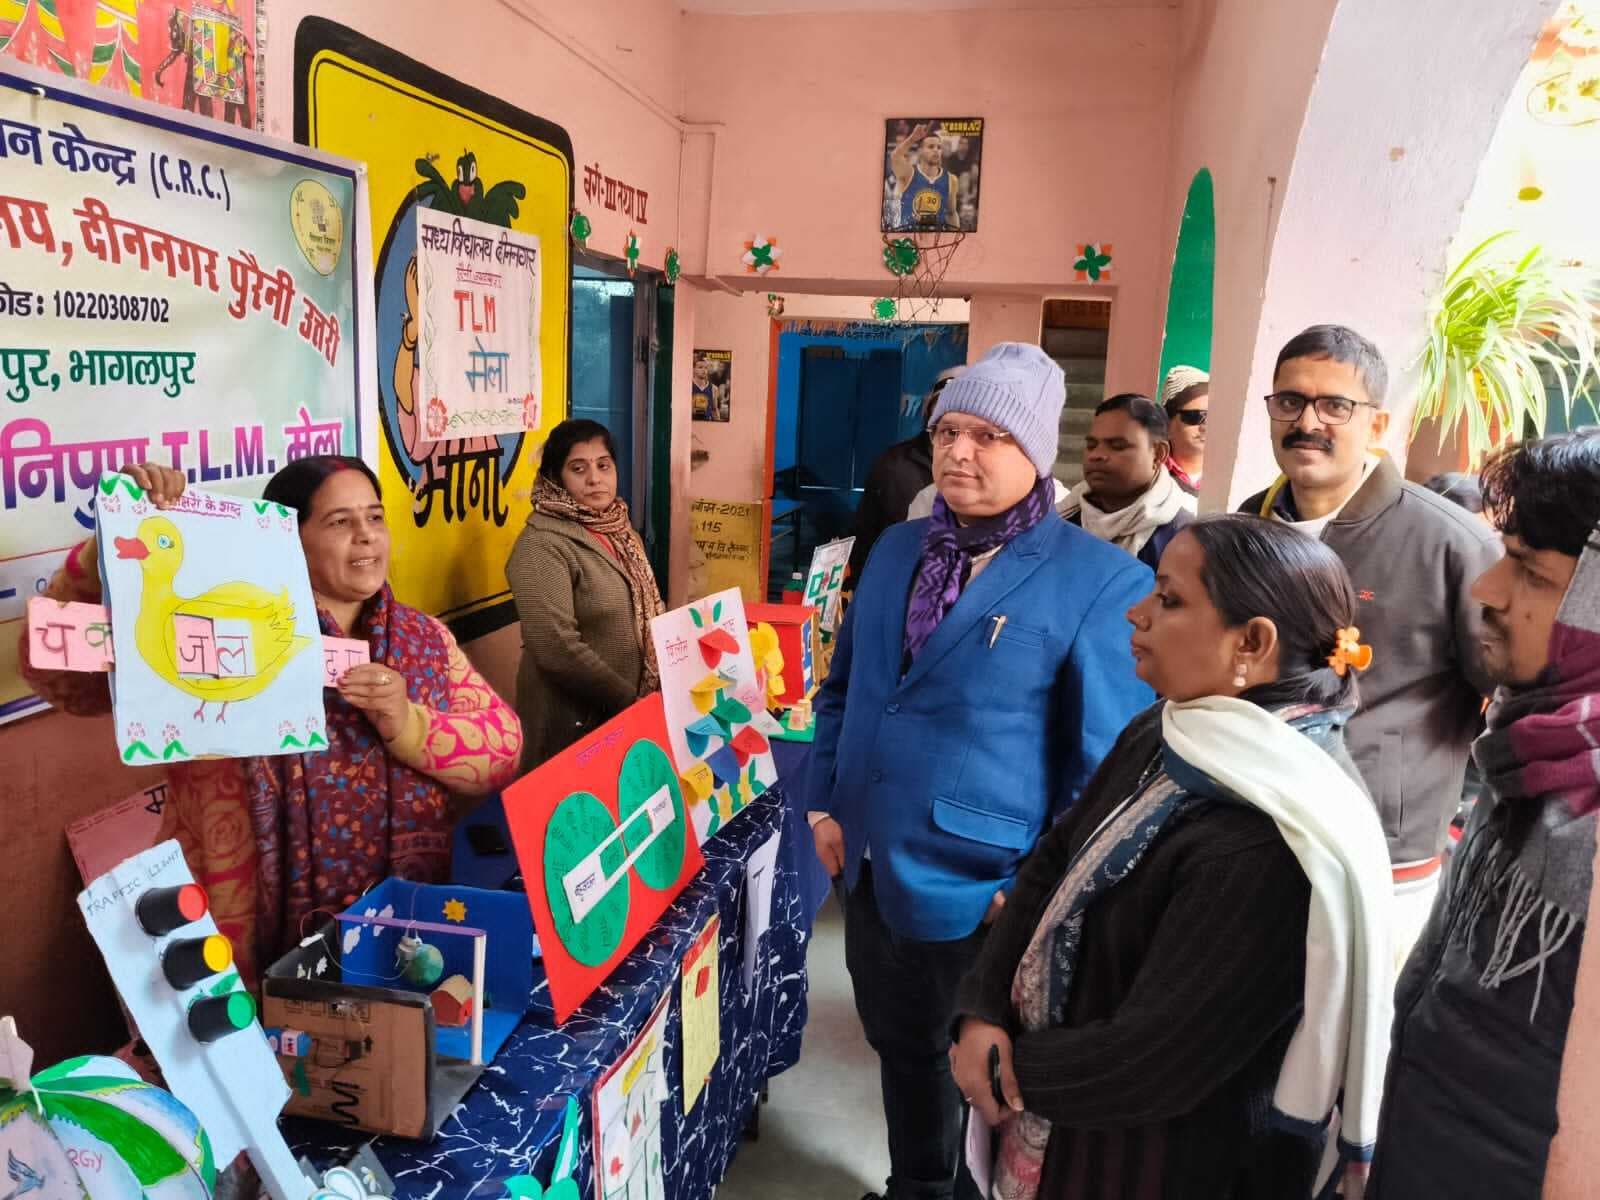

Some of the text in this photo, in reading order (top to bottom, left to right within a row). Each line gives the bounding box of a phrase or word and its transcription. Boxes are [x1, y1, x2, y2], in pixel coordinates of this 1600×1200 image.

[48, 122, 136, 186] केन्द्र
[150, 152, 230, 211] (C.R.C.)
[636, 189, 648, 224] IV
[73, 197, 219, 293] दीननगर
[228, 249, 295, 327] पुरैनी
[421, 224, 451, 255] मध्य
[54, 290, 168, 322] 10220308702
[454, 290, 496, 333] TLM
[69, 350, 197, 398] भागलपुर
[464, 335, 510, 392] मेला
[162, 426, 276, 483] T.L.M.
[285, 406, 341, 464] मेला
